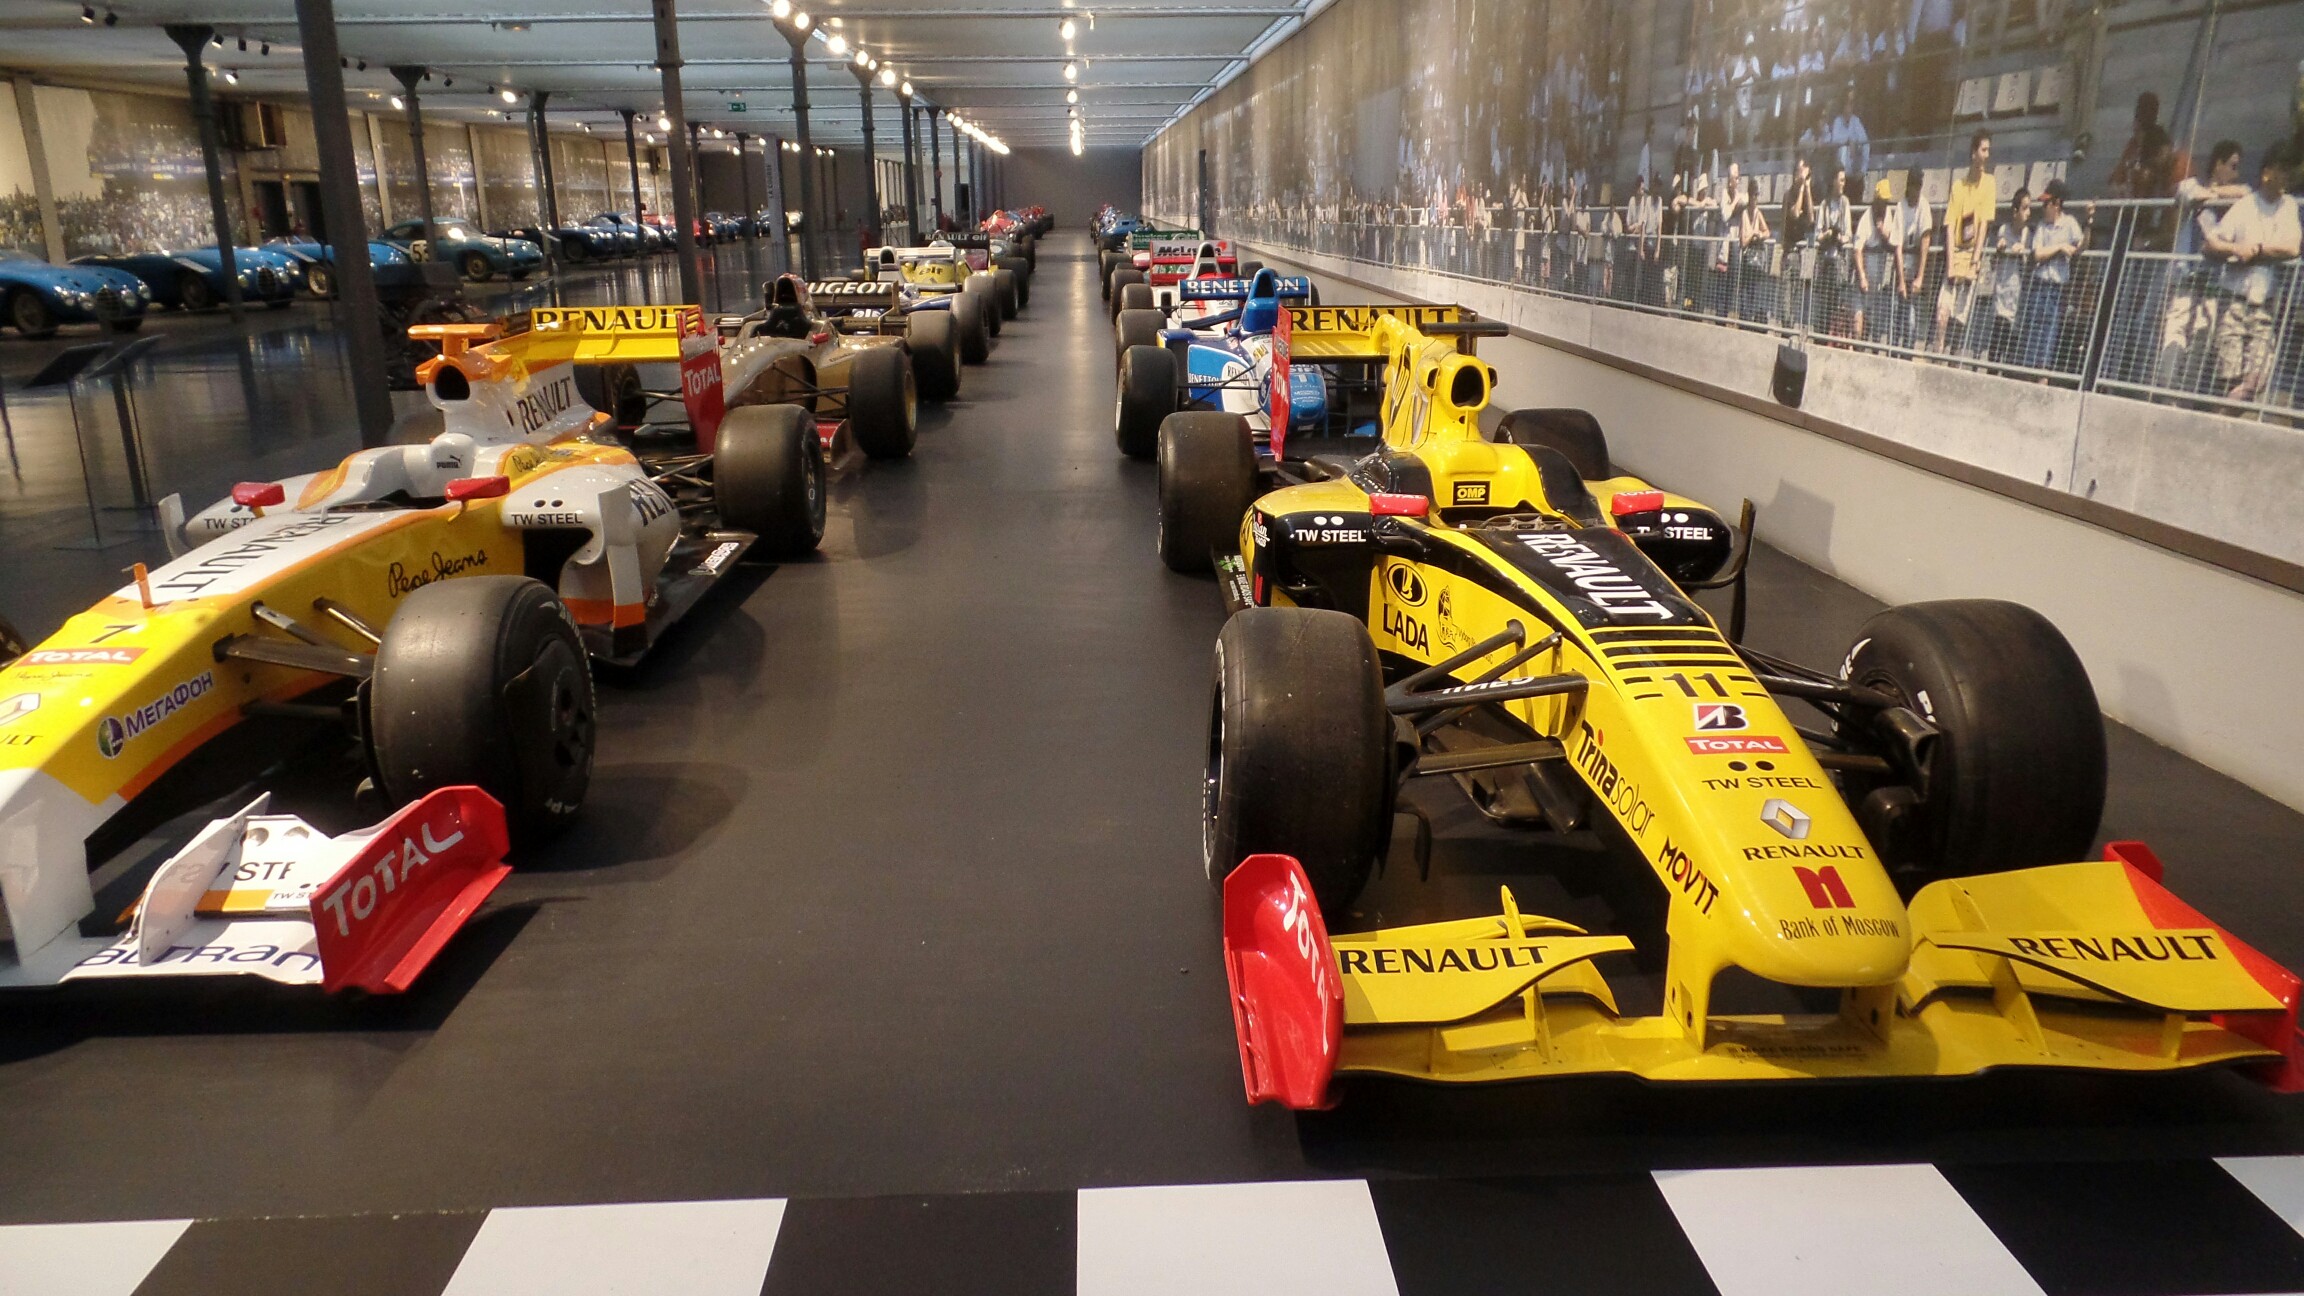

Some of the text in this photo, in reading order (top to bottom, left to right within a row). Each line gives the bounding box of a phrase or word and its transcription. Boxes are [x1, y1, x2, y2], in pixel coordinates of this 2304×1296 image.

[685, 363, 721, 397] TOTAL
[1457, 487, 1486, 499] OMP
[204, 518, 227, 530] TW
[511, 513, 583, 526] TW STEEL
[1295, 529, 1367, 543] TW STEEL
[1664, 526, 1713, 541] STEEL
[1516, 533, 1675, 620] RENAULT
[90, 624, 138, 644] 7
[1383, 603, 1430, 657] LADA
[30, 650, 132, 663] TOTAL
[1662, 673, 1730, 697] 11
[124, 672, 214, 738] МЕГАФОН
[1688, 739, 1784, 751] TOTAL
[1702, 776, 1822, 791] TW STEEL
[1742, 845, 1865, 861] RENAULT
[322, 822, 465, 938] TOTAL
[1779, 915, 1901, 941] Bank of Moscow
[2007, 935, 2219, 962] RENAULT
[1283, 869, 1330, 1057] TOTAL
[1336, 945, 1549, 975] RENAULT
